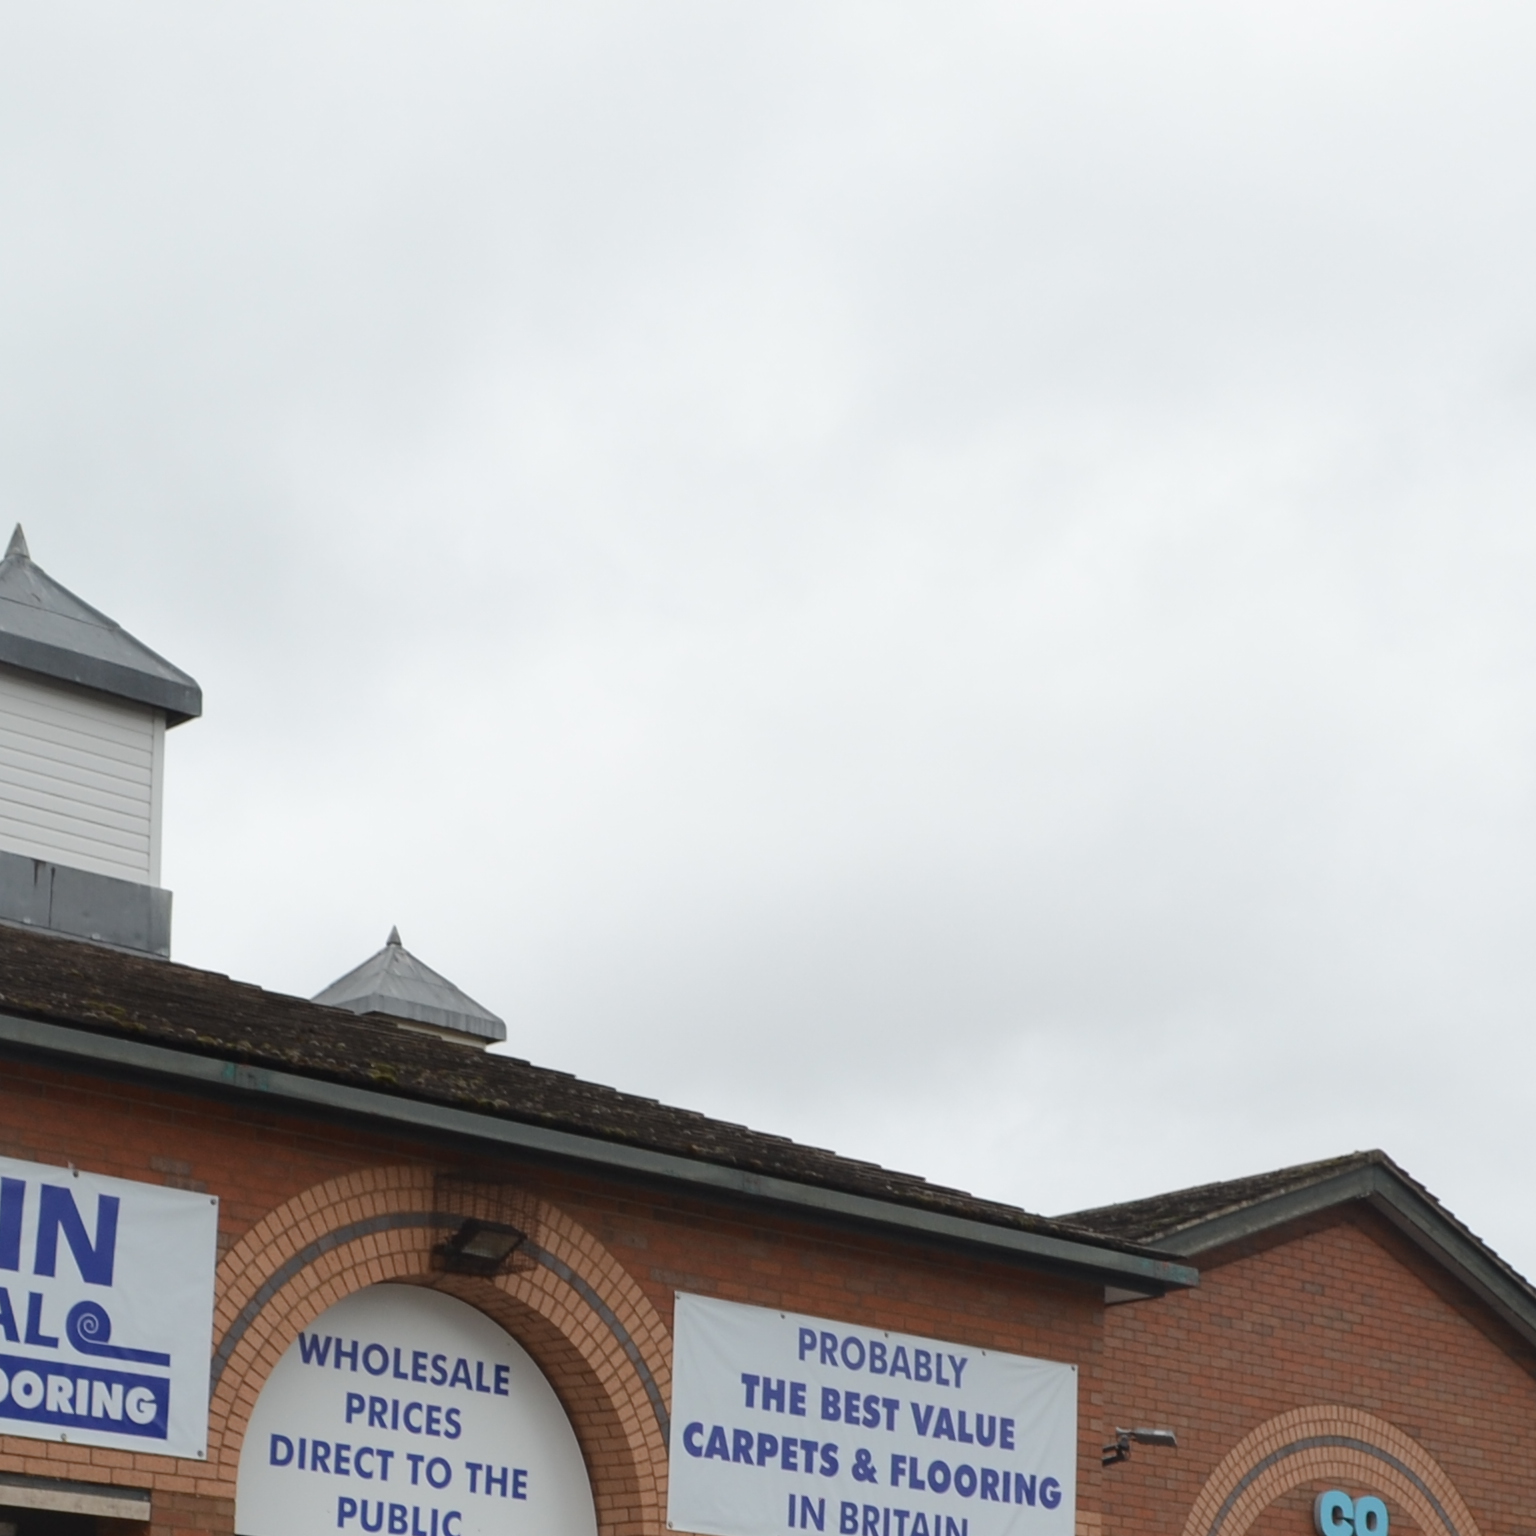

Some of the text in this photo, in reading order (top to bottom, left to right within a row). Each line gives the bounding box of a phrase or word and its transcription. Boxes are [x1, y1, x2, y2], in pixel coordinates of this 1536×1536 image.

[298, 1331, 511, 1396] WHOLESALE
[798, 1326, 968, 1389] PROBABLY
[345, 1392, 462, 1440] PRICES
[741, 1373, 1015, 1451] THE BEST VALUE
[269, 1433, 528, 1501] DIRECT TO THE
[682, 1421, 1062, 1510] CARPETS & FLOORING
[787, 1493, 825, 1532] IN
